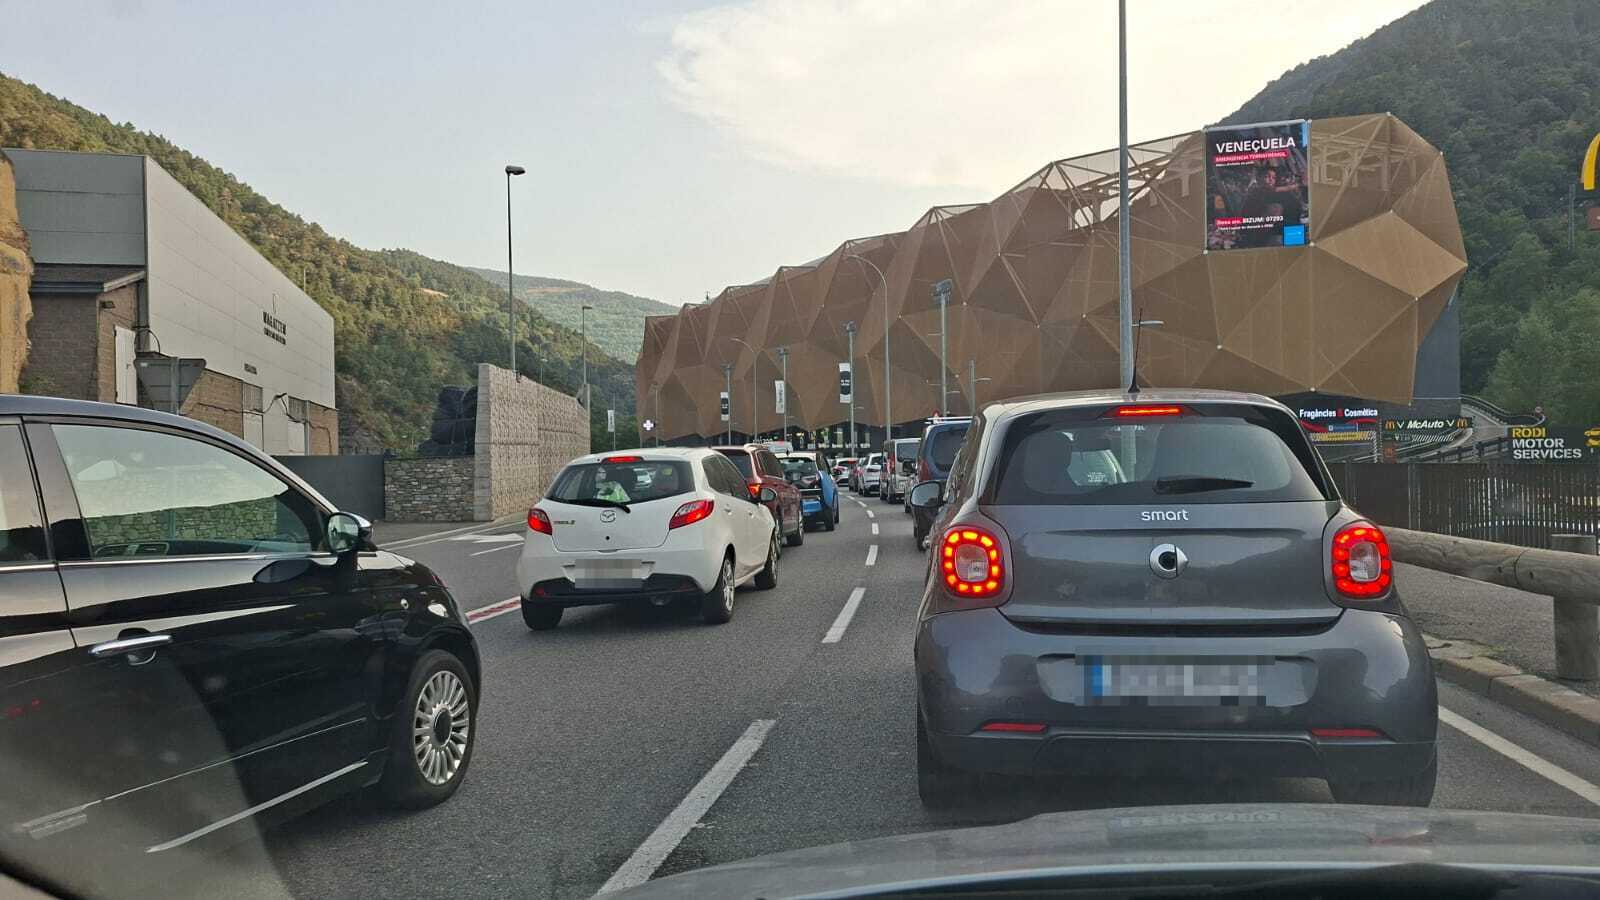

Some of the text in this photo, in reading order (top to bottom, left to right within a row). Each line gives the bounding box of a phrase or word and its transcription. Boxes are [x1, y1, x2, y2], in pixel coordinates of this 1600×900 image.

[1215, 136, 1296, 153] VENEÇUELA
[1406, 419, 1445, 429] McAuto
[1512, 428, 1546, 438] RODI
[1512, 438, 1565, 449] MOTOR
[1513, 448, 1582, 459] SERVICES
[1141, 508, 1189, 521] smart
